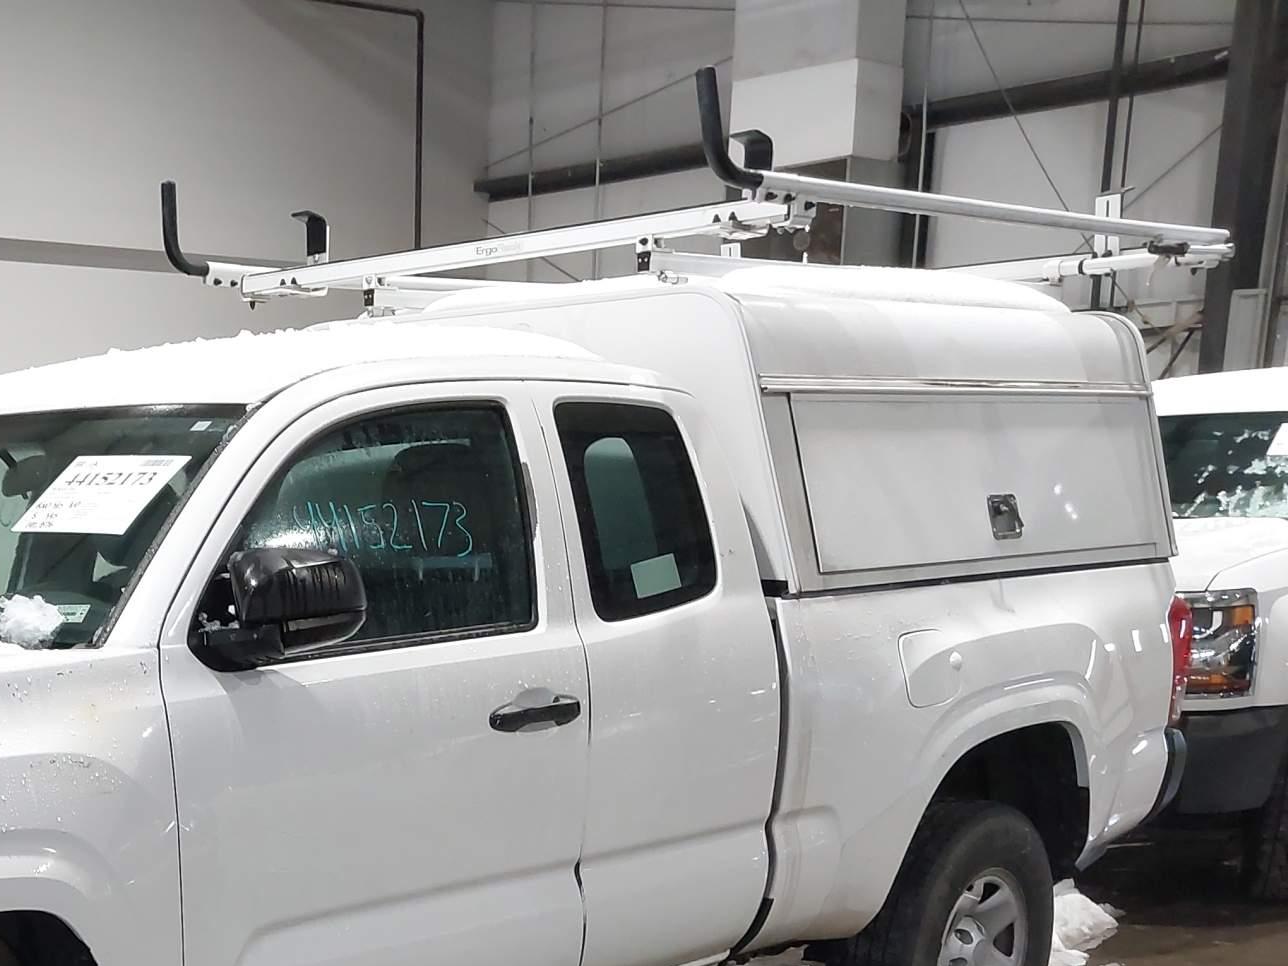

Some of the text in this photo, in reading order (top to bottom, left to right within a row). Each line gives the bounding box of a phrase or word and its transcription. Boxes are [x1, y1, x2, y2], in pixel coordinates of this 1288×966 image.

[476, 246, 498, 256] Ergo
[65, 471, 158, 486] 44152173
[292, 499, 473, 558] 44152173
